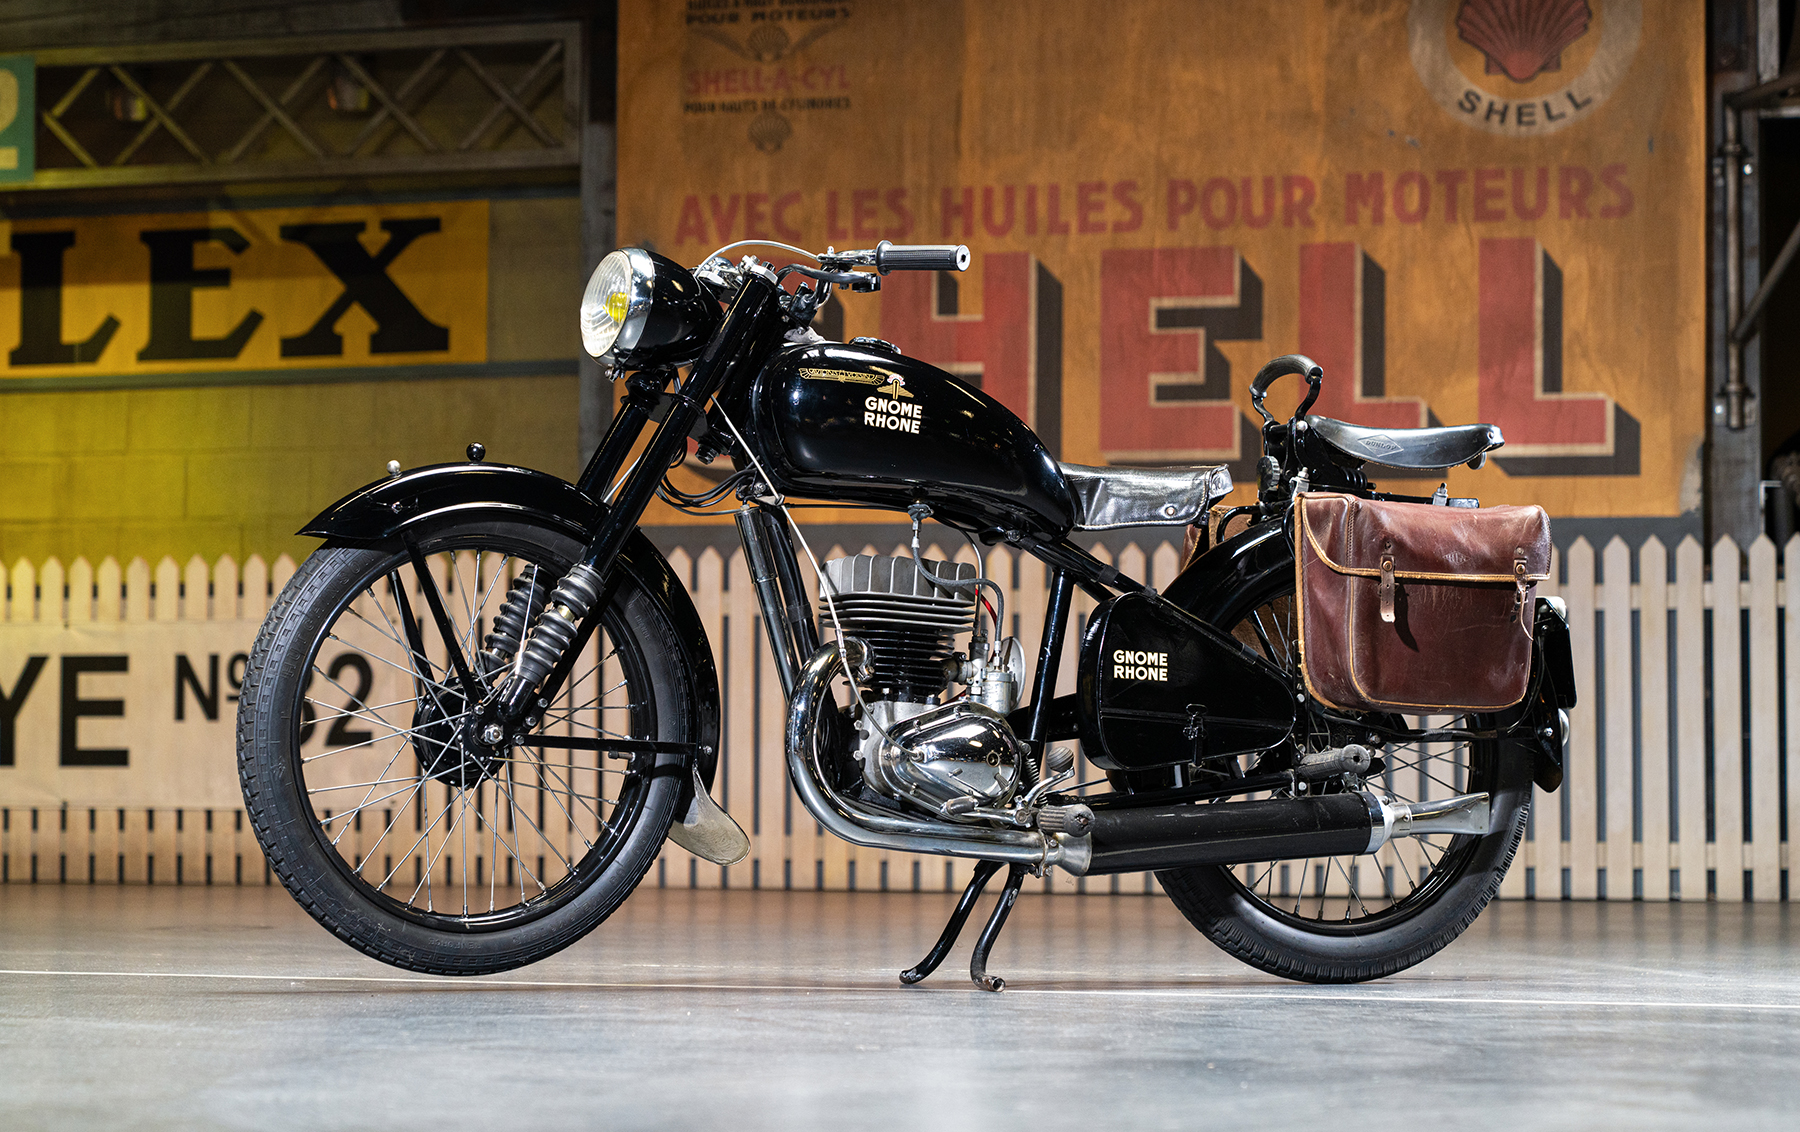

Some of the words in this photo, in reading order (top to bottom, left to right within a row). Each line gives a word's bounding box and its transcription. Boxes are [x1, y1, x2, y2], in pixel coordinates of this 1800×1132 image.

[1457, 88, 1593, 127] SHELL
[675, 191, 801, 246] AVEC
[826, 187, 914, 241] LES
[941, 180, 1144, 238] HUILES
[1166, 174, 1316, 231] POUR
[1345, 162, 1636, 226] MOTEURS
[9, 216, 450, 367] LEX
[864, 396, 923, 419] GNOME
[864, 411, 921, 434] RHONE
[1113, 649, 1168, 666] GNOME
[1113, 664, 1168, 682] RHONE
